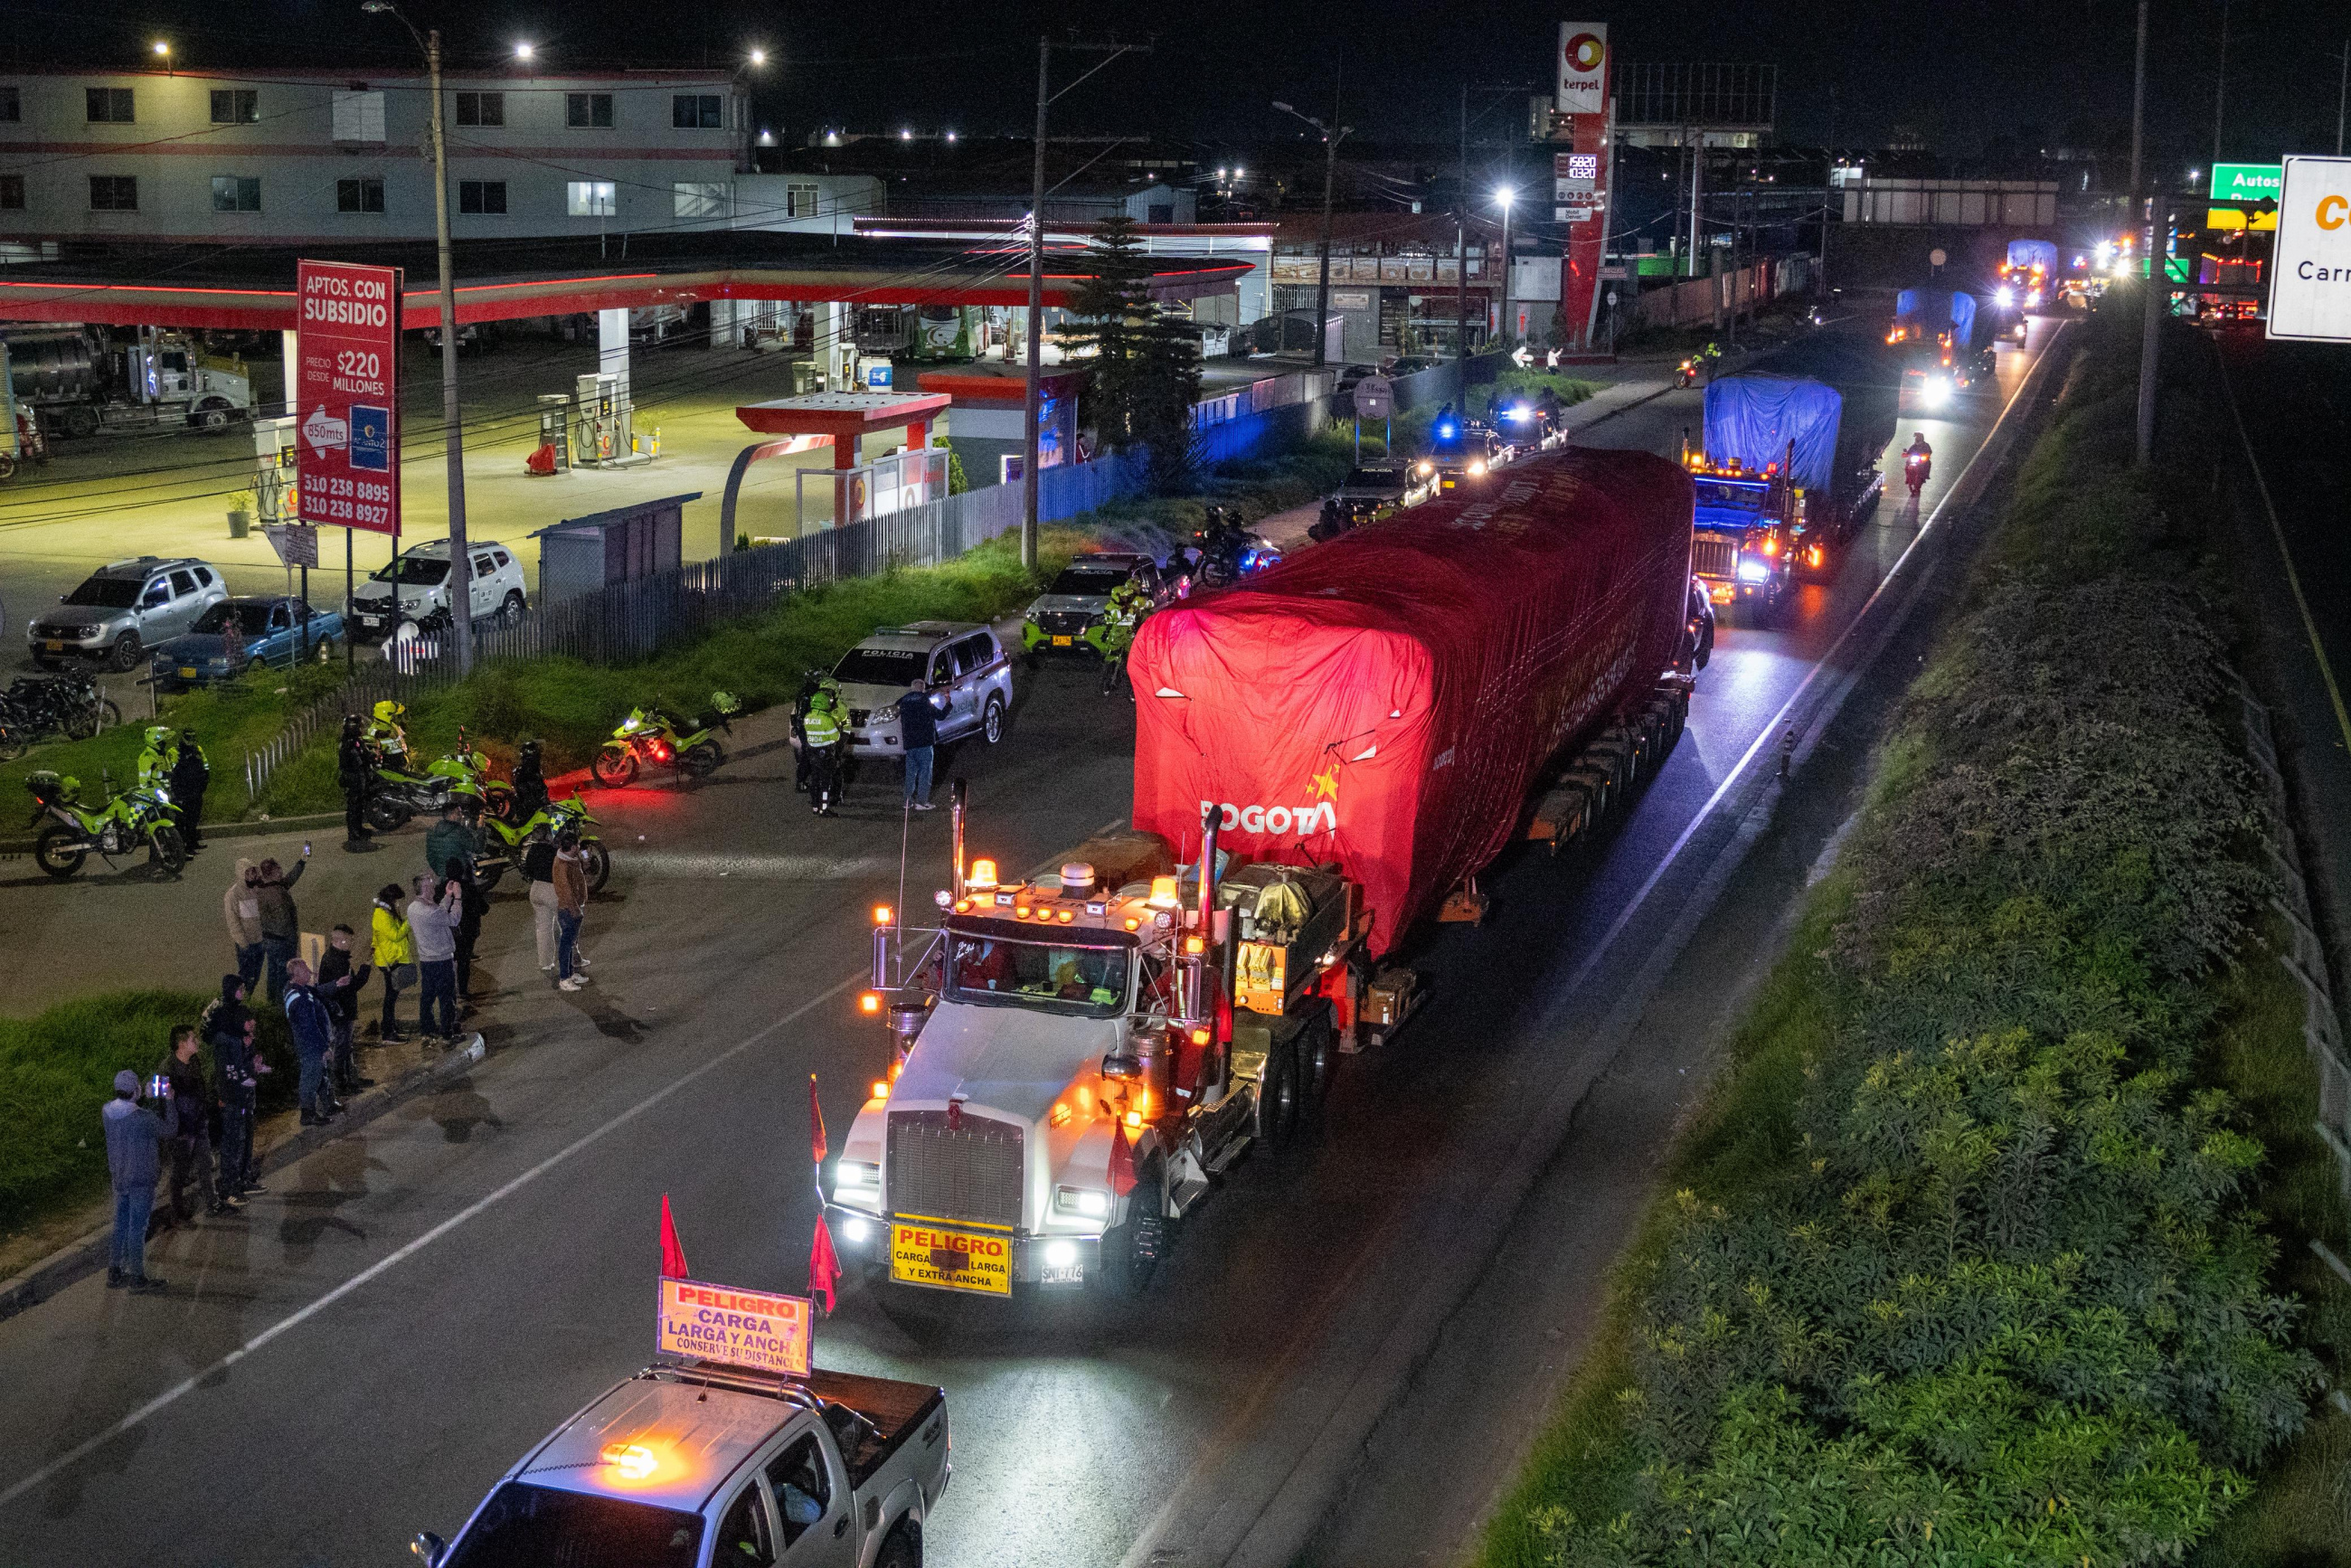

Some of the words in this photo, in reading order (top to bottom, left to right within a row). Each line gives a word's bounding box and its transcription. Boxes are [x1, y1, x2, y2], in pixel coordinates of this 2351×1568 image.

[1563, 78, 1600, 92] terpel
[1569, 156, 1597, 168] 15820
[1569, 167, 1596, 179] 10320
[306, 275, 352, 298] APTOS.
[354, 279, 386, 300] CON
[304, 298, 387, 327] SUBSIDIO
[306, 356, 332, 369] PRECIO
[337, 350, 380, 379] $220
[307, 371, 330, 383] DESDE
[333, 376, 385, 396] MILLONES
[307, 424, 344, 441] 850mts
[304, 474, 327, 493] 310
[329, 477, 354, 497] 238
[356, 482, 390, 503] 8895
[304, 496, 327, 515] 310
[329, 499, 354, 519] 238
[355, 504, 389, 524] 8927
[900, 1229, 1003, 1257] PELIGRO
[895, 1251, 931, 1264] CARGA
[970, 1261, 1006, 1274] LARGA
[909, 1267, 915, 1277] Y
[918, 1268, 953, 1280] EXTRA
[955, 1273, 992, 1287] ANCHA
[678, 1287, 797, 1319] PELIGRO
[668, 1320, 727, 1344] LARGA
[730, 1332, 740, 1345] Y
[698, 1308, 772, 1335] CARGA
[676, 1337, 730, 1357] CONSERVE
[731, 1347, 743, 1357] SU
